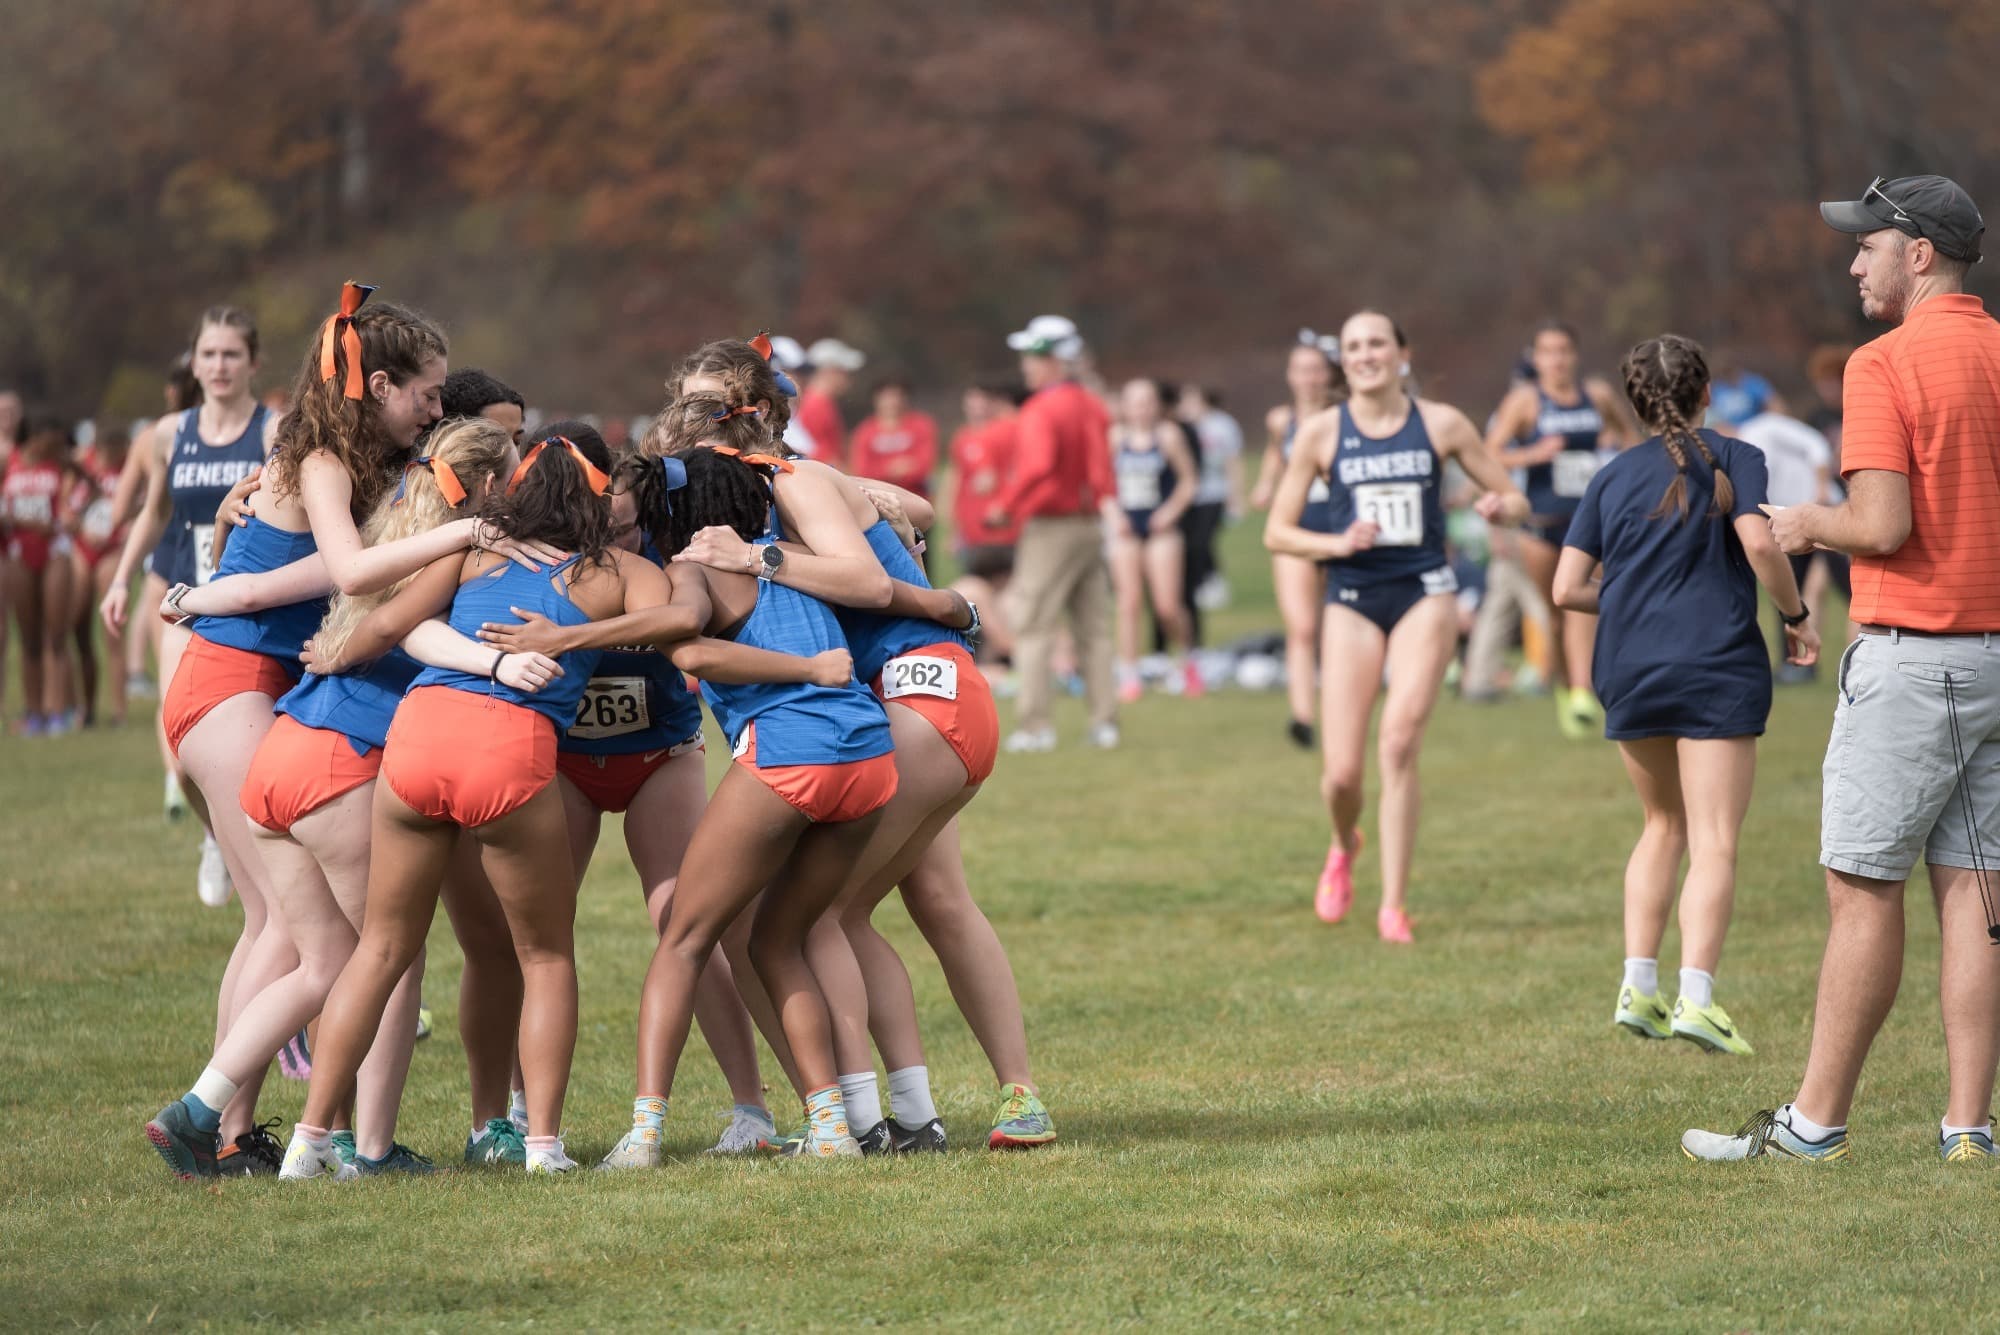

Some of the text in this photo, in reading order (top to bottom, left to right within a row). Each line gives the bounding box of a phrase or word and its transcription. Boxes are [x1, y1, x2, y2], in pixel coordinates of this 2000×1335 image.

[1340, 450, 1431, 484] GENESEO
[896, 662, 943, 688] 262
[575, 694, 639, 727] 263
